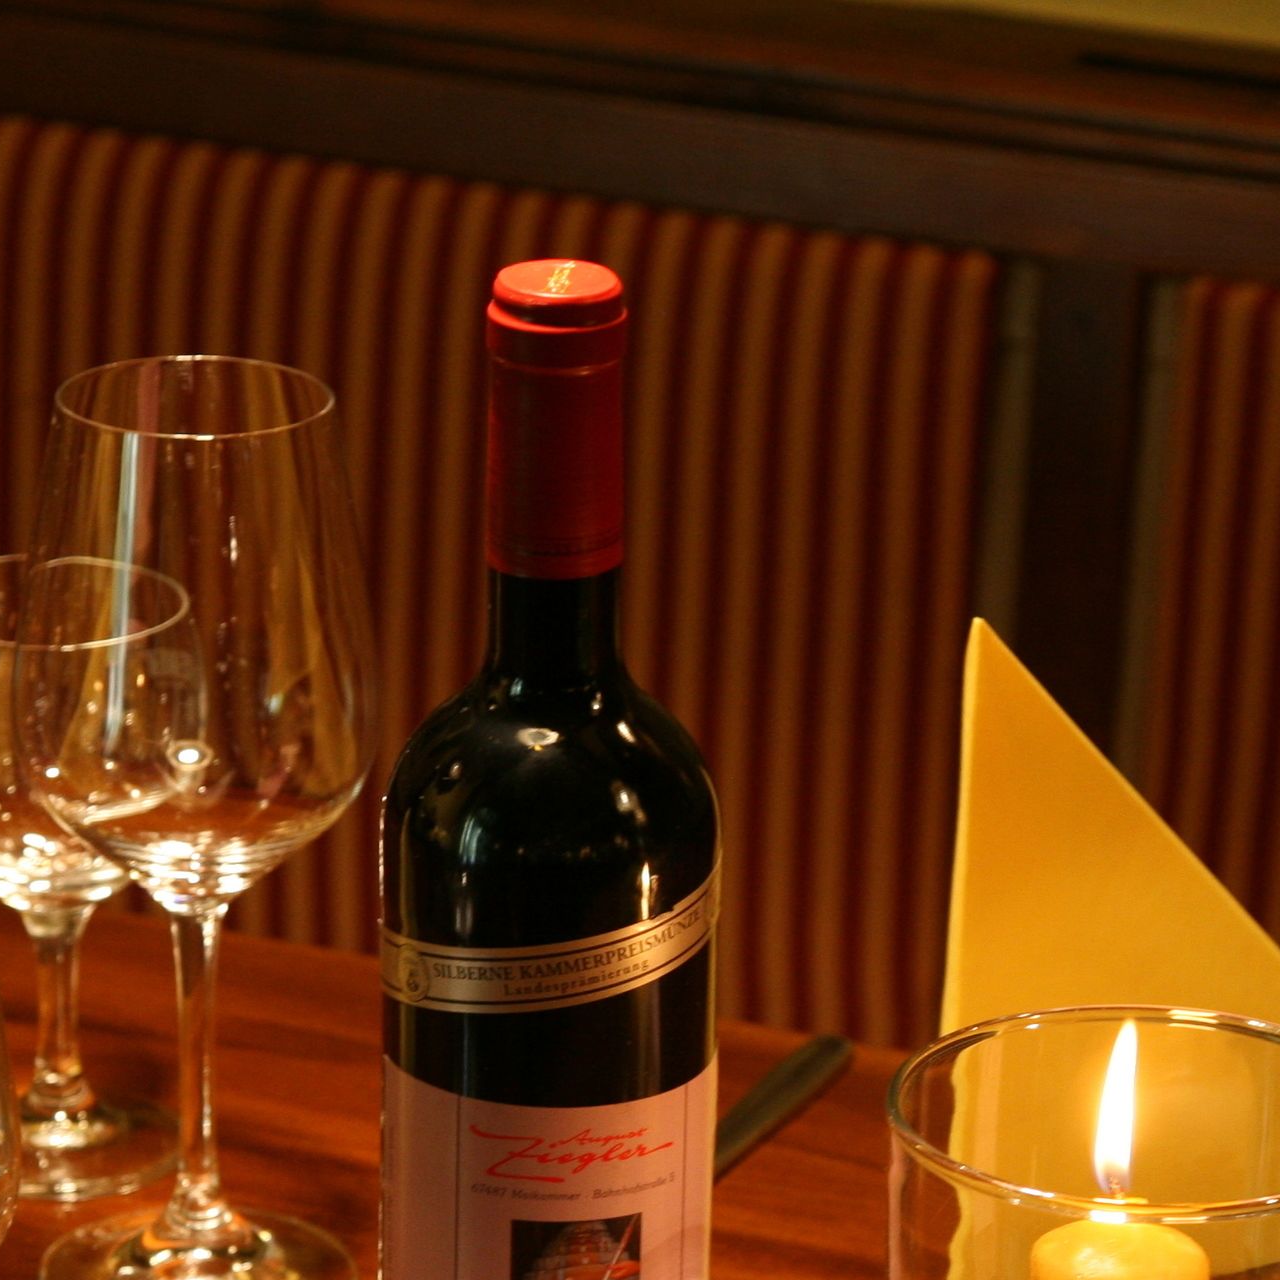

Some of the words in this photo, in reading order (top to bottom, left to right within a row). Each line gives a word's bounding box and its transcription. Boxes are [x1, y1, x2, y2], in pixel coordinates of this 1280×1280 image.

[432, 963, 516, 981] SILBERNE
[520, 907, 701, 978] KAMMERPREISMÜNZE
[504, 959, 650, 996] Landesprämierung
[469, 1124, 674, 1183] Ziegler
